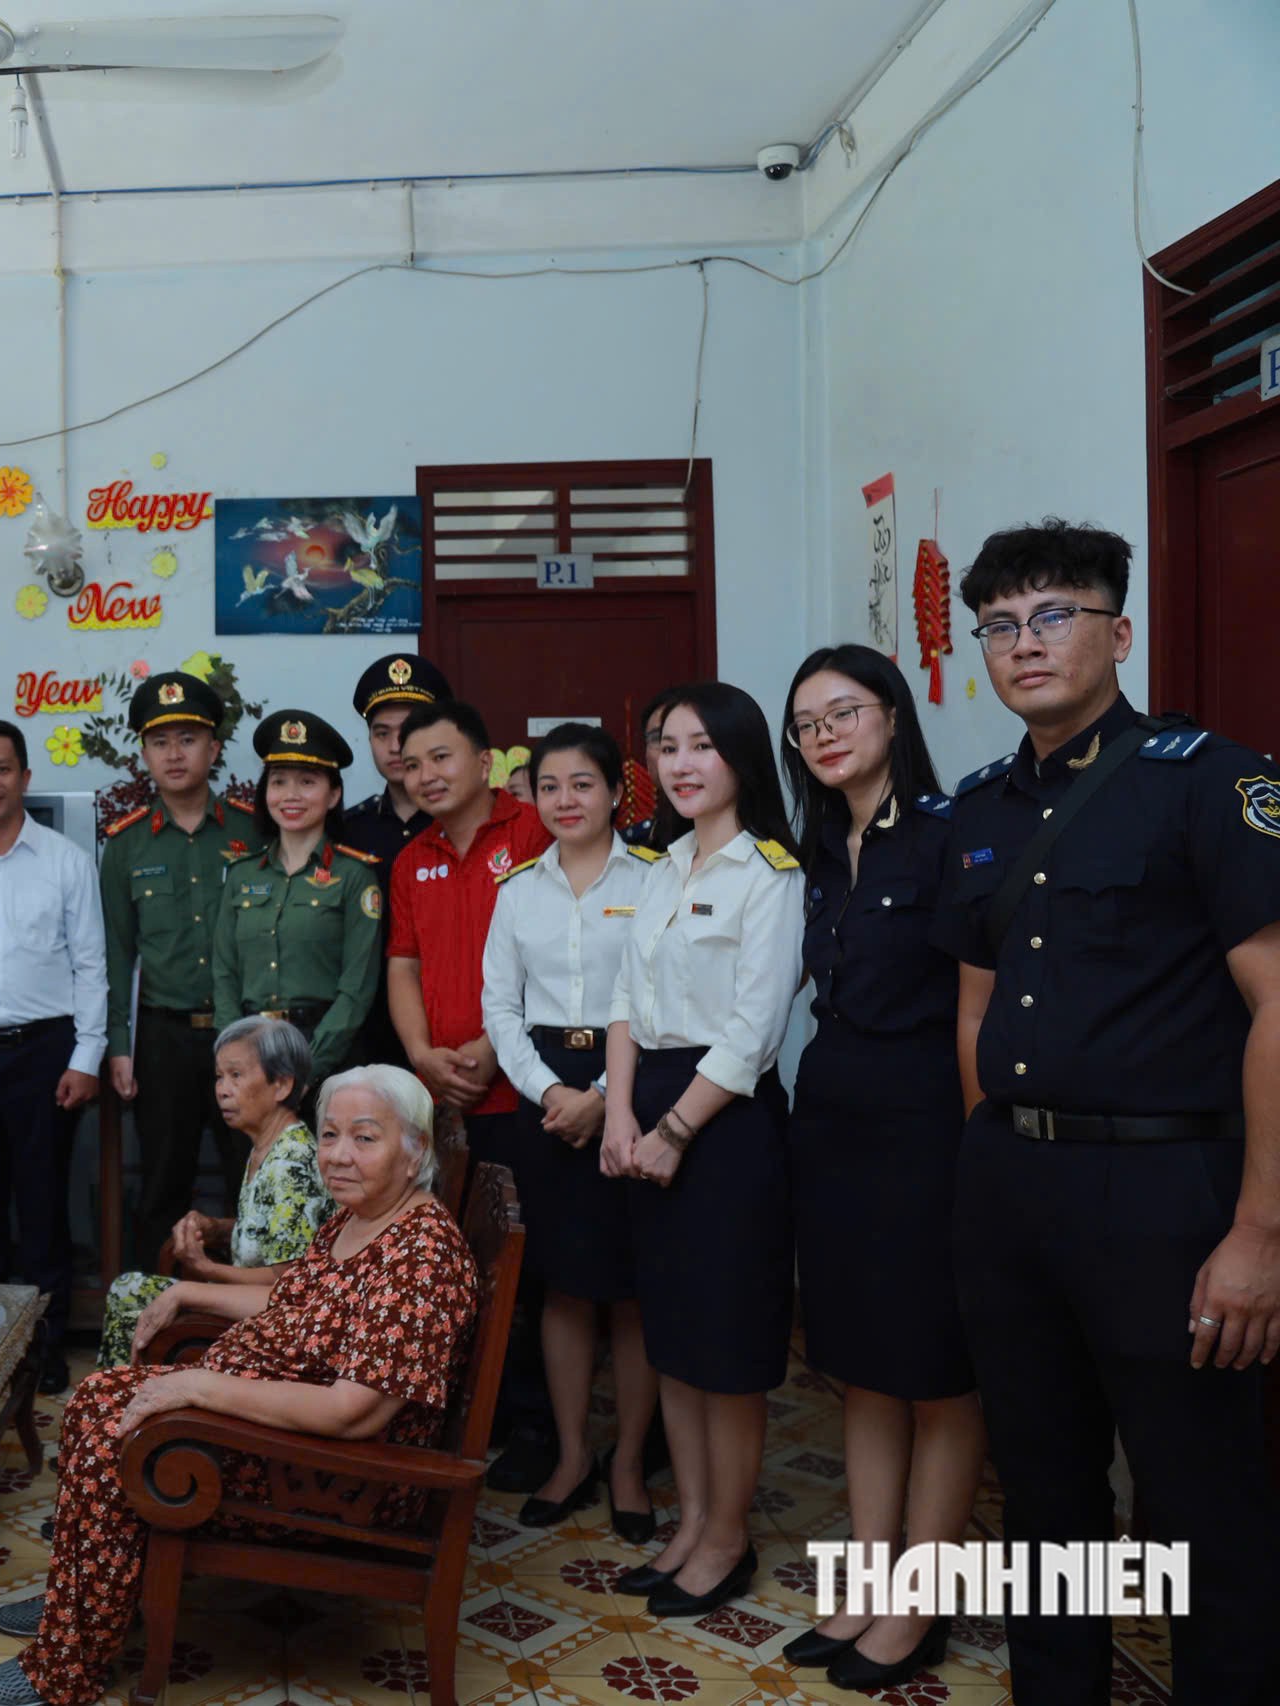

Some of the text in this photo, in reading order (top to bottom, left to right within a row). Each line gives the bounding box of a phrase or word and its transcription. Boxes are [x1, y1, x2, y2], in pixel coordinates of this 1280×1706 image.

[86, 480, 214, 533] Happy
[542, 561, 578, 584] P.1
[68, 582, 161, 624] New
[15, 670, 103, 718] Year
